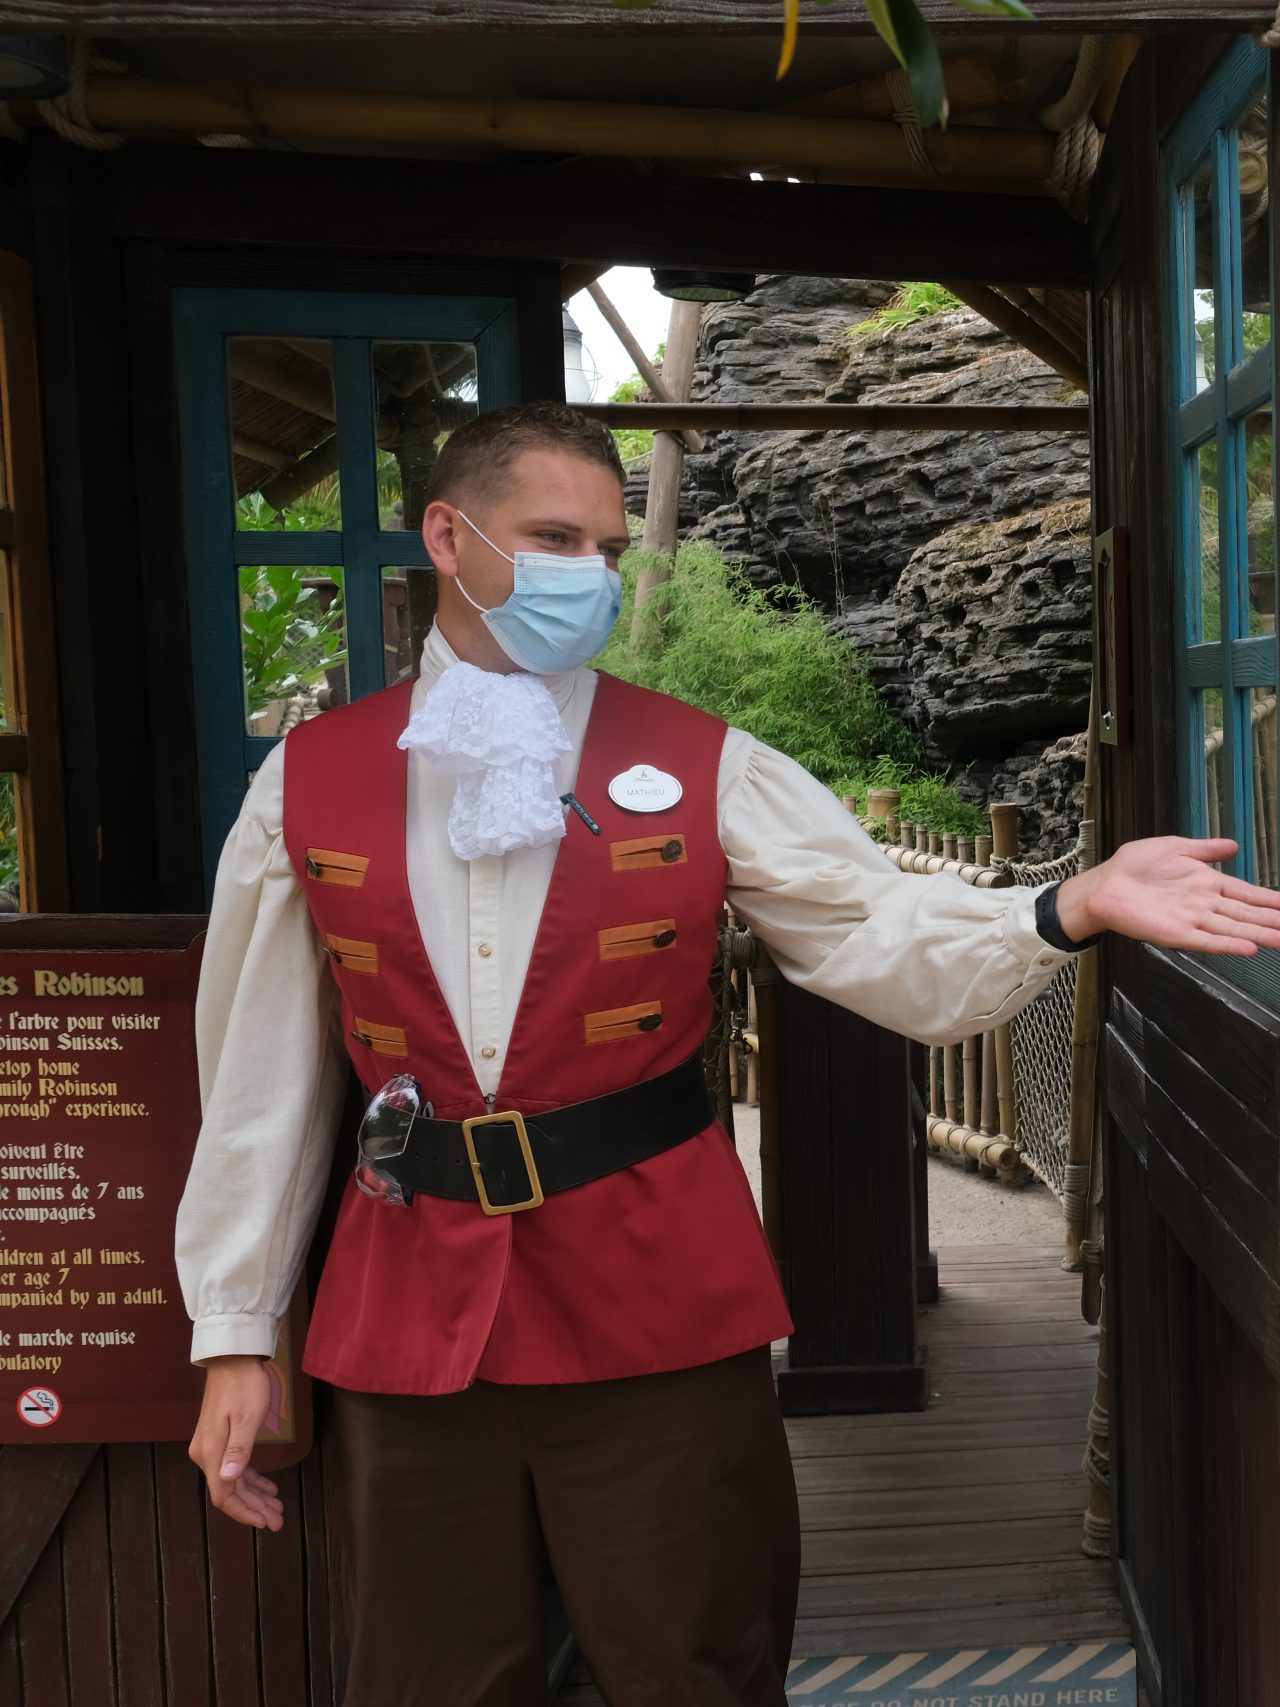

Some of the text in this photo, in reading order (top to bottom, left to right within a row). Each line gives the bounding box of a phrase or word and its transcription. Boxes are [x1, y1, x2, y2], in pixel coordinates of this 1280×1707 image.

[626, 788, 665, 797] MATHIEU
[34, 970, 145, 997] Robinson
[9, 1011, 60, 1031] l'arbre
[67, 1014, 104, 1033] pour
[112, 1013, 161, 1031] visiter
[57, 1033, 124, 1052] Suisses.
[38, 1058, 80, 1077] home
[39, 1078, 118, 1097] Robinson
[65, 1100, 150, 1120] experience.
[0, 1142, 85, 1160] oivent être
[1, 1162, 80, 1180] surveillés.
[17, 1184, 65, 1201] moins
[71, 1183, 90, 1200] de
[97, 1181, 110, 1200] 7
[117, 1186, 145, 1200] ans
[0, 1203, 96, 1225] ccompagnés
[51, 1249, 66, 1265] at
[73, 1248, 92, 1265] all
[99, 1248, 146, 1265] times.
[0, 1267, 70, 1289] er age 7
[70, 1289, 90, 1310] by
[97, 1291, 116, 1305] an
[123, 1287, 168, 1305] adult.
[18, 1329, 74, 1347] marche
[81, 1329, 136, 1348] requise
[968, 1692, 1046, 1707] STAND
[1056, 1688, 1118, 1706] HERE
